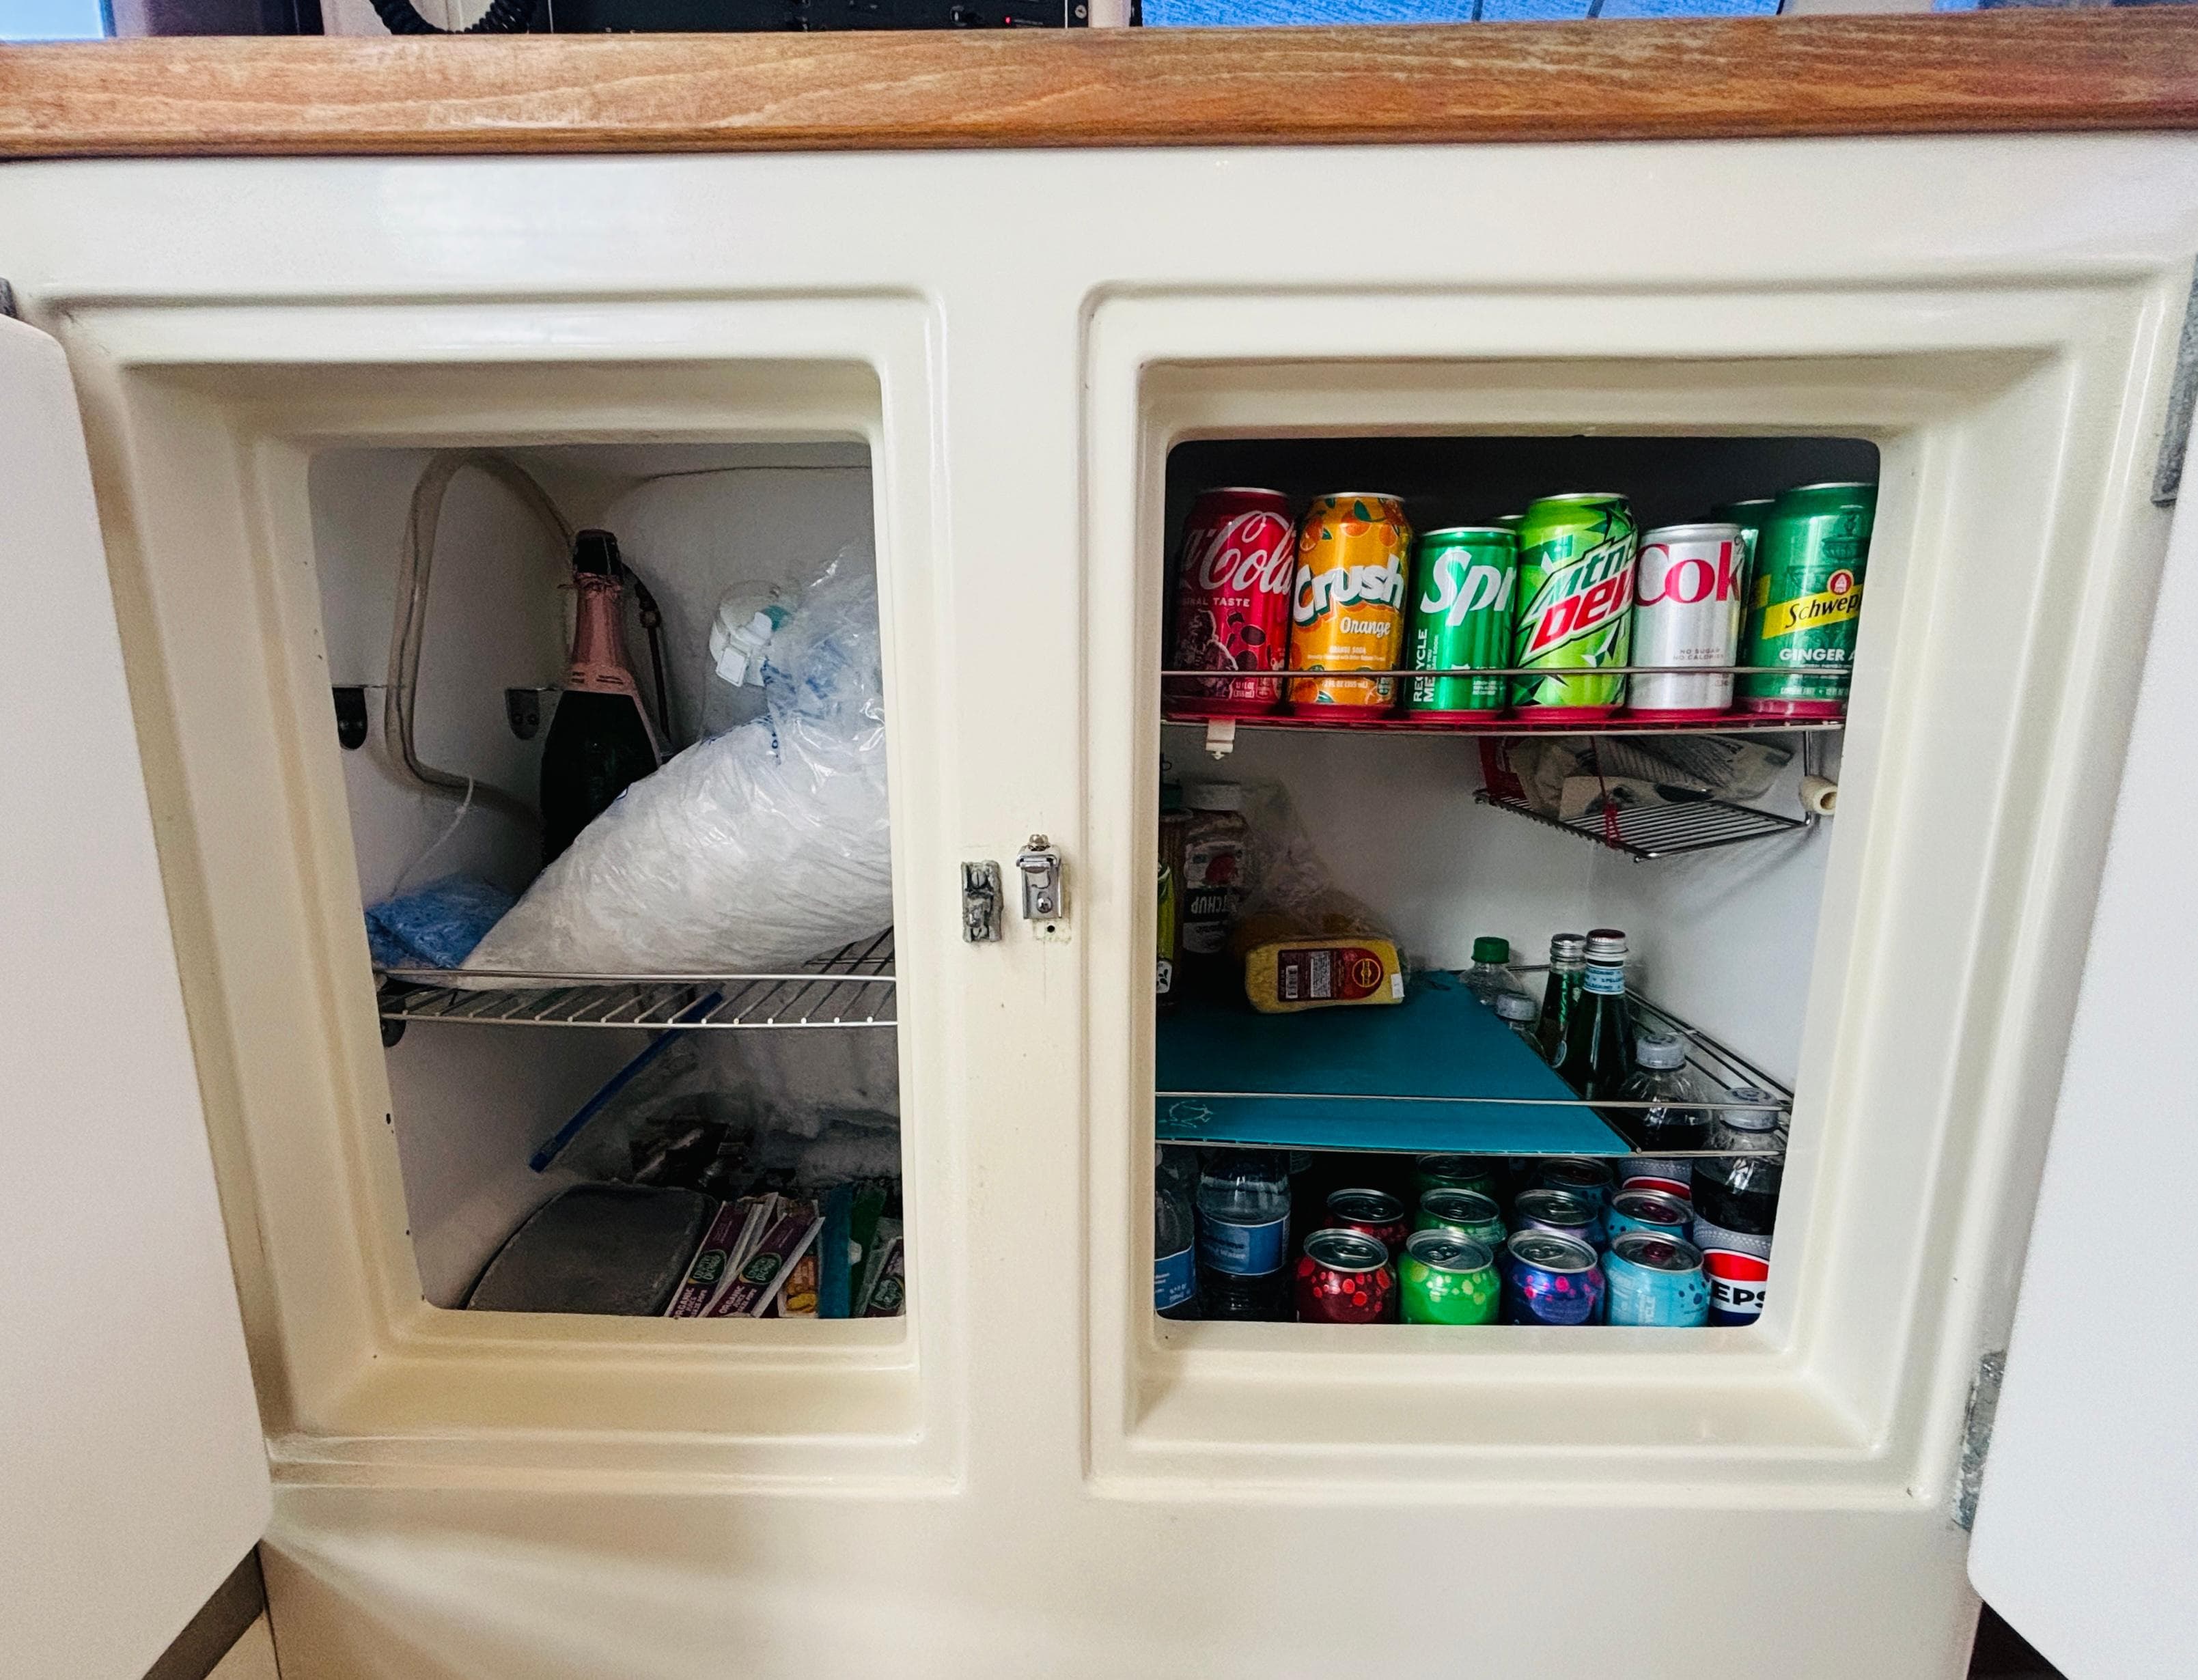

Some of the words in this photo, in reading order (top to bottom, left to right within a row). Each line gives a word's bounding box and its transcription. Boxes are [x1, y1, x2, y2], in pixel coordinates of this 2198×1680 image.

[1294, 554, 1404, 621] Crush
[1532, 546, 1626, 615] Mtn
[1213, 597, 1251, 607] TASTE
[1785, 593, 1861, 628] Schwep
[1340, 617, 1391, 636] Orange
[1779, 647, 1846, 661] GINGER
